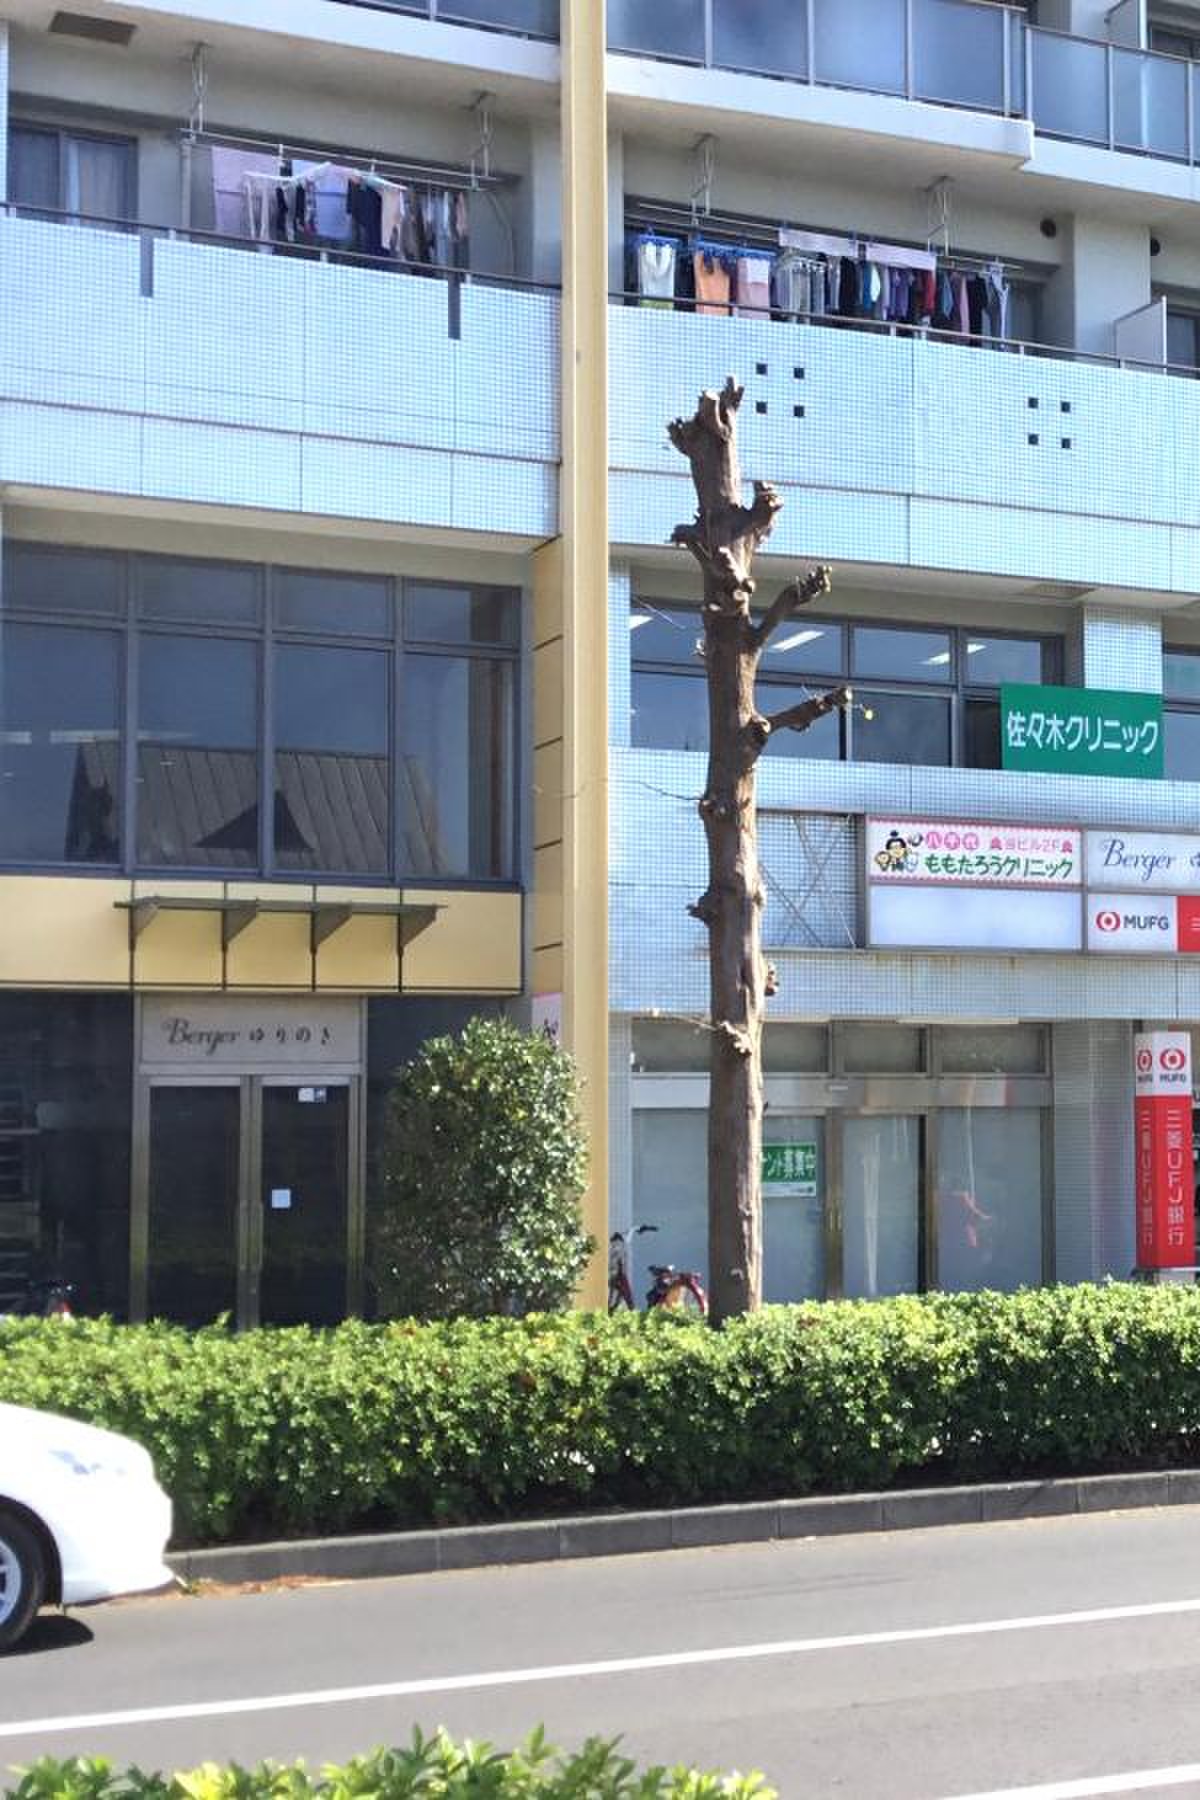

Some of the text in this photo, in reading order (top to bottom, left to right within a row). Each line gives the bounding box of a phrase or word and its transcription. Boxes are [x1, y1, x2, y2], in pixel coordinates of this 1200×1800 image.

[1007, 710, 1159, 755] 佐々木クリニック
[924, 853, 1074, 879] ももたろうクリニック
[1103, 839, 1175, 881] Berger
[1123, 914, 1170, 931] MUFG
[162, 1017, 241, 1056] Berger
[763, 1149, 816, 1179] ント募集中
